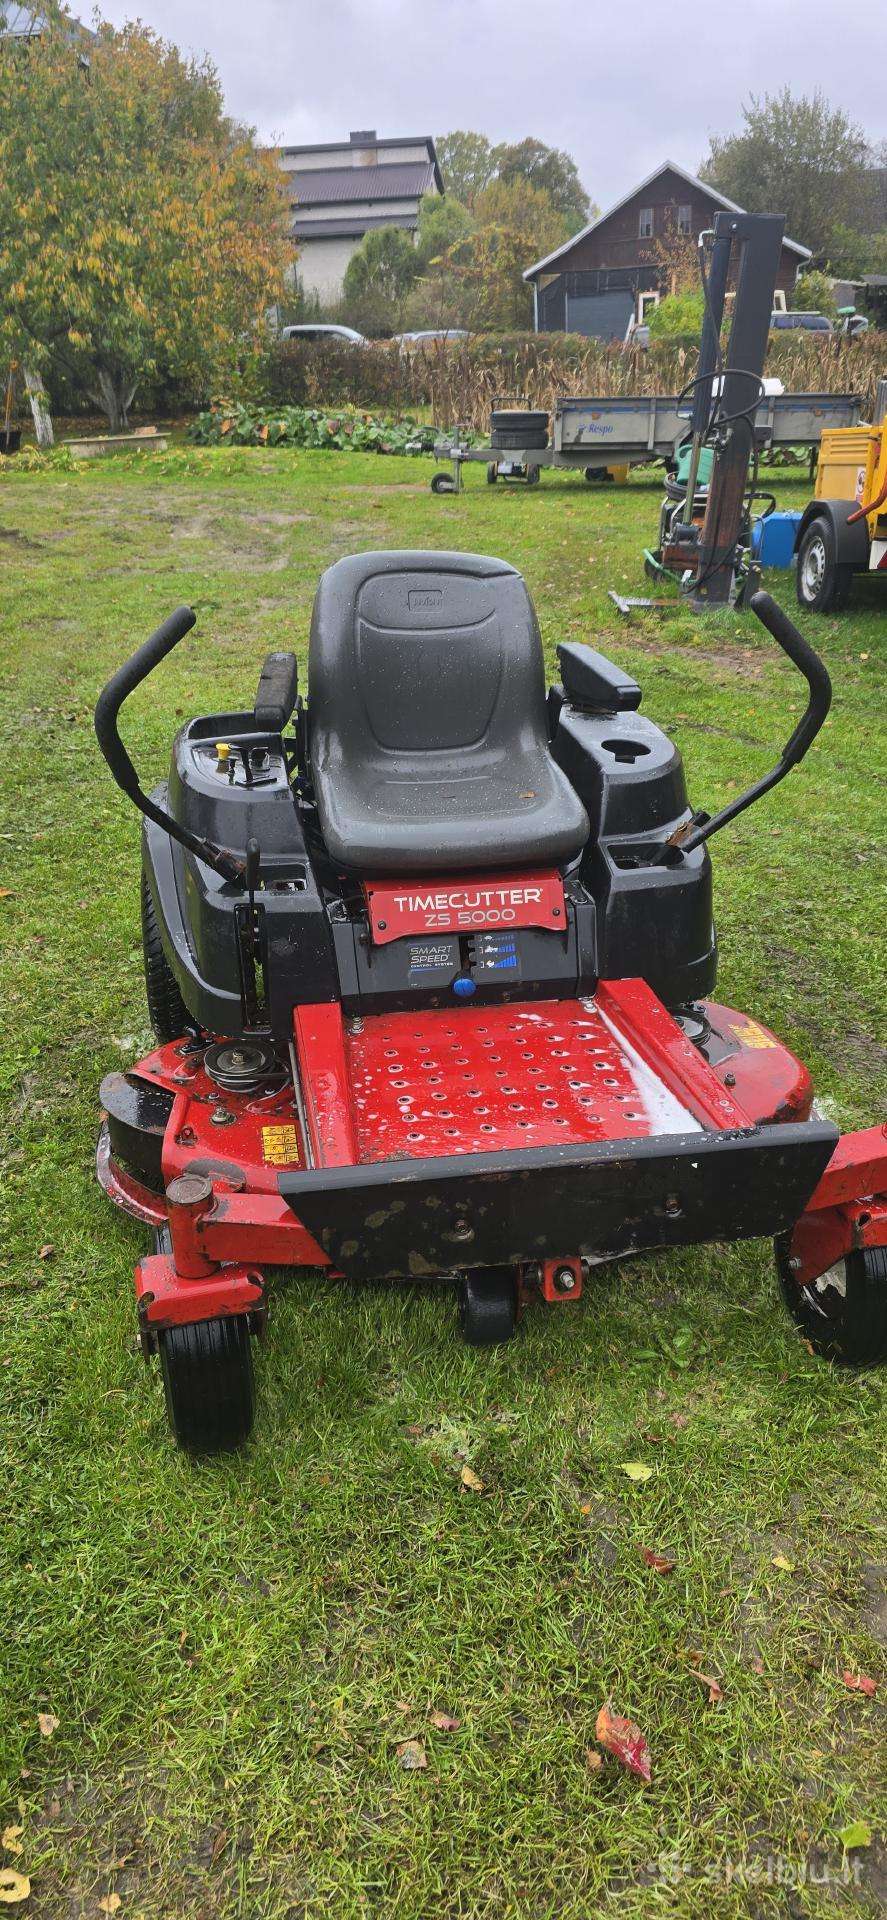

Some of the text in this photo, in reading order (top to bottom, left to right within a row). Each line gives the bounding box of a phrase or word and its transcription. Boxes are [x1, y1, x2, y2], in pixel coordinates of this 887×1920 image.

[588, 423, 614, 436] Respo
[394, 888, 543, 912] TIMECUTTER
[424, 908, 516, 927] ZS 5000
[410, 945, 453, 955] SMART
[410, 954, 450, 964] SPEED
